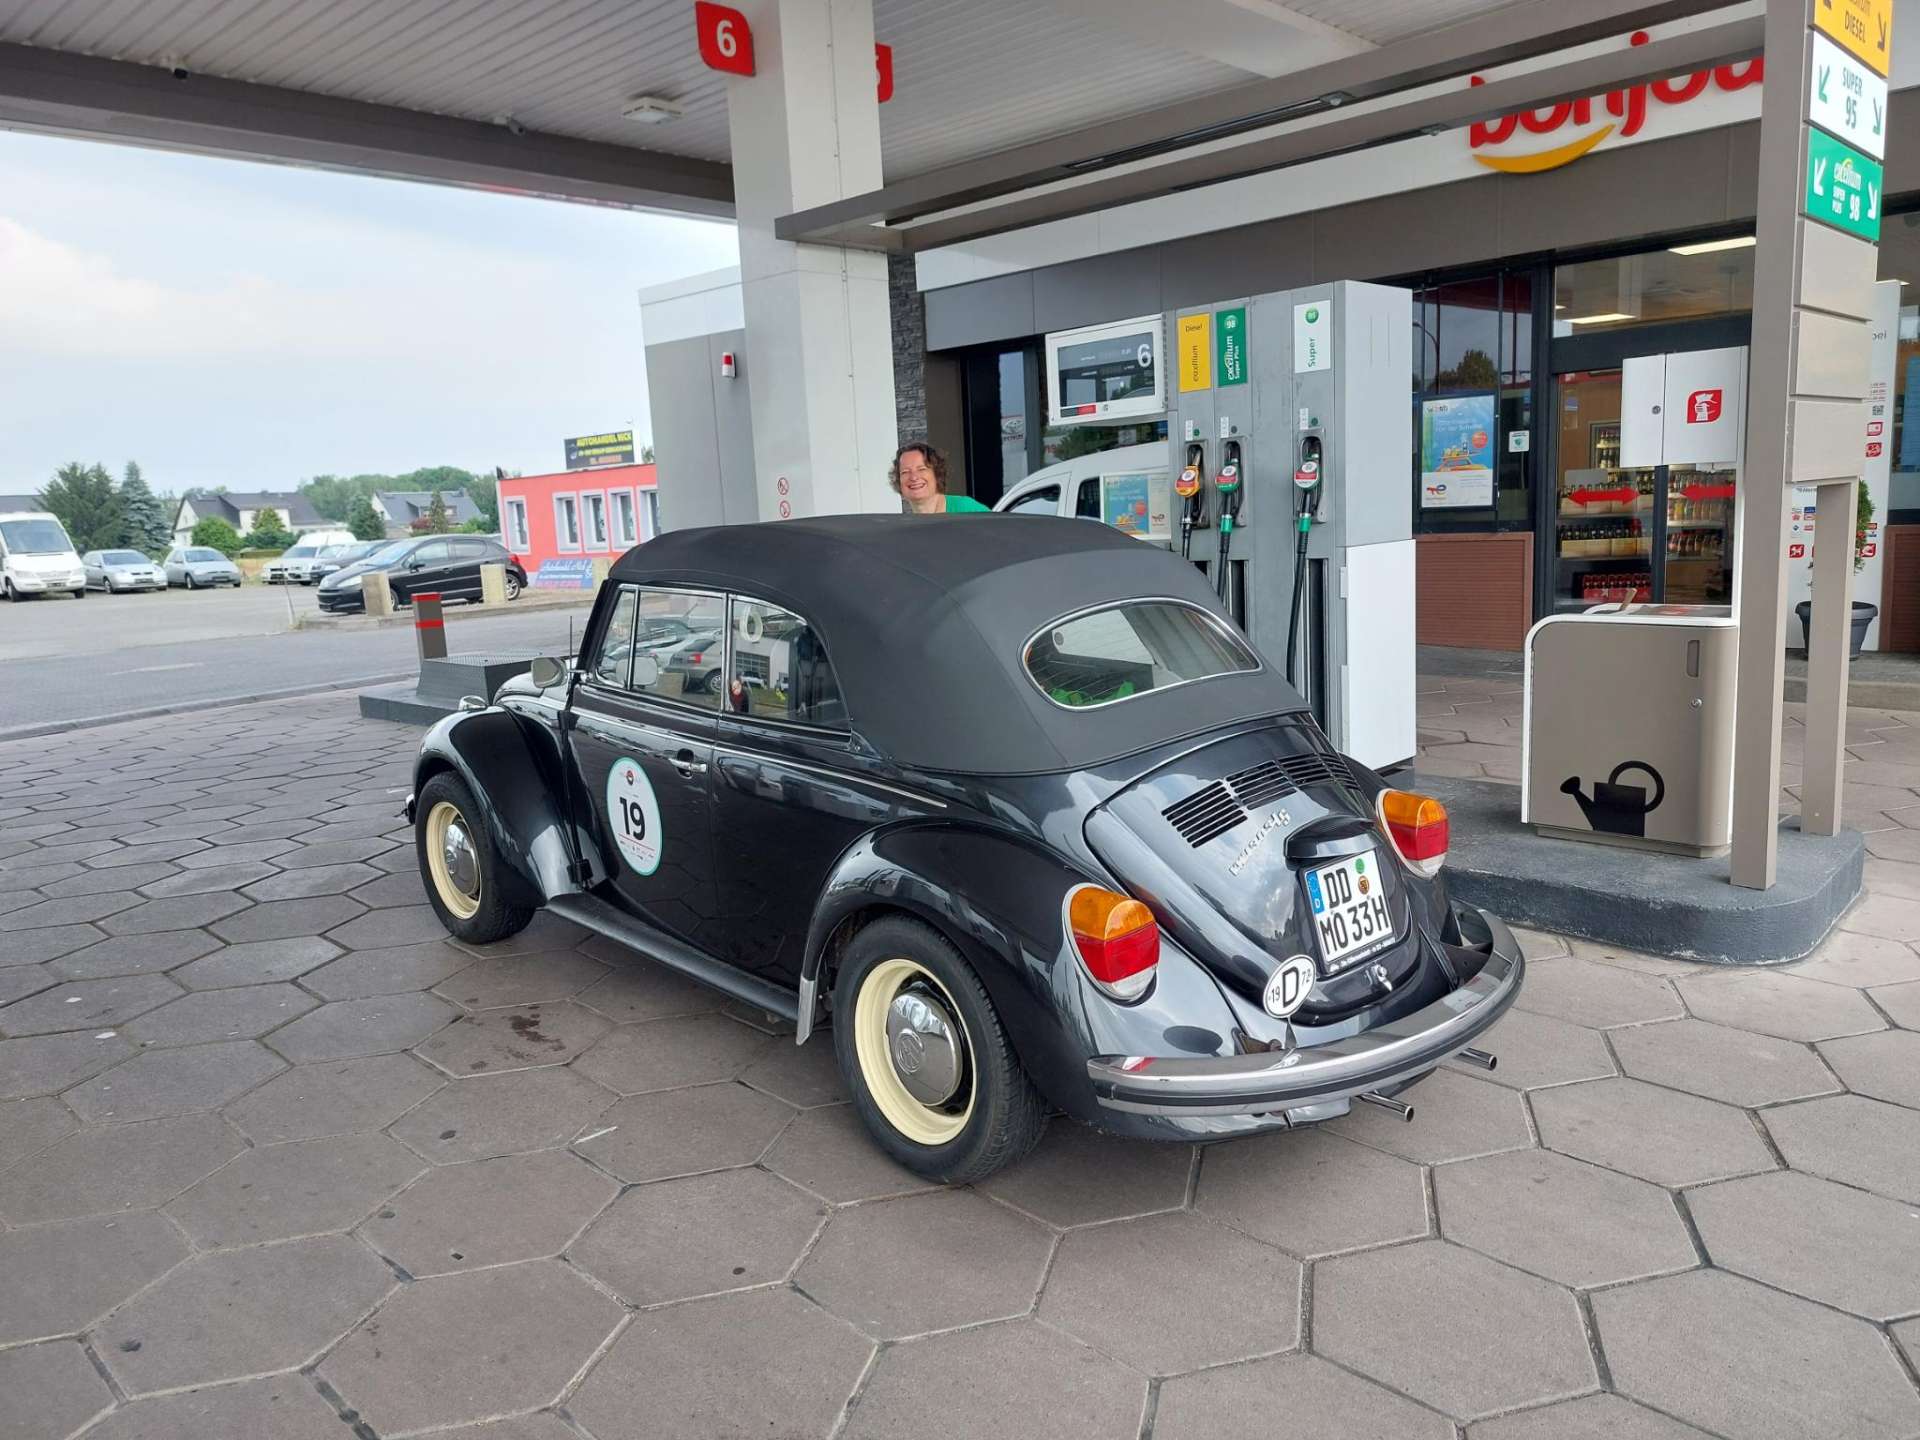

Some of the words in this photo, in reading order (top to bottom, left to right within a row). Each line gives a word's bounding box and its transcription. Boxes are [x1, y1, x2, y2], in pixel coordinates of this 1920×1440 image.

[716, 19, 737, 58] 6
[1844, 10, 1866, 44] DIESEL
[1842, 66, 1863, 97] SUPER
[1845, 96, 1857, 129] 95
[1849, 193, 1860, 221] 98
[1185, 323, 1203, 333] Diesel
[1137, 343, 1152, 368] 6
[1307, 337, 1317, 368] Super
[619, 796, 646, 841] 19
[1314, 898, 1321, 910] D
[1323, 867, 1352, 910] DD
[1319, 911, 1349, 955] MO
[1271, 985, 1281, 1004] 19
[1282, 966, 1299, 1008] D
